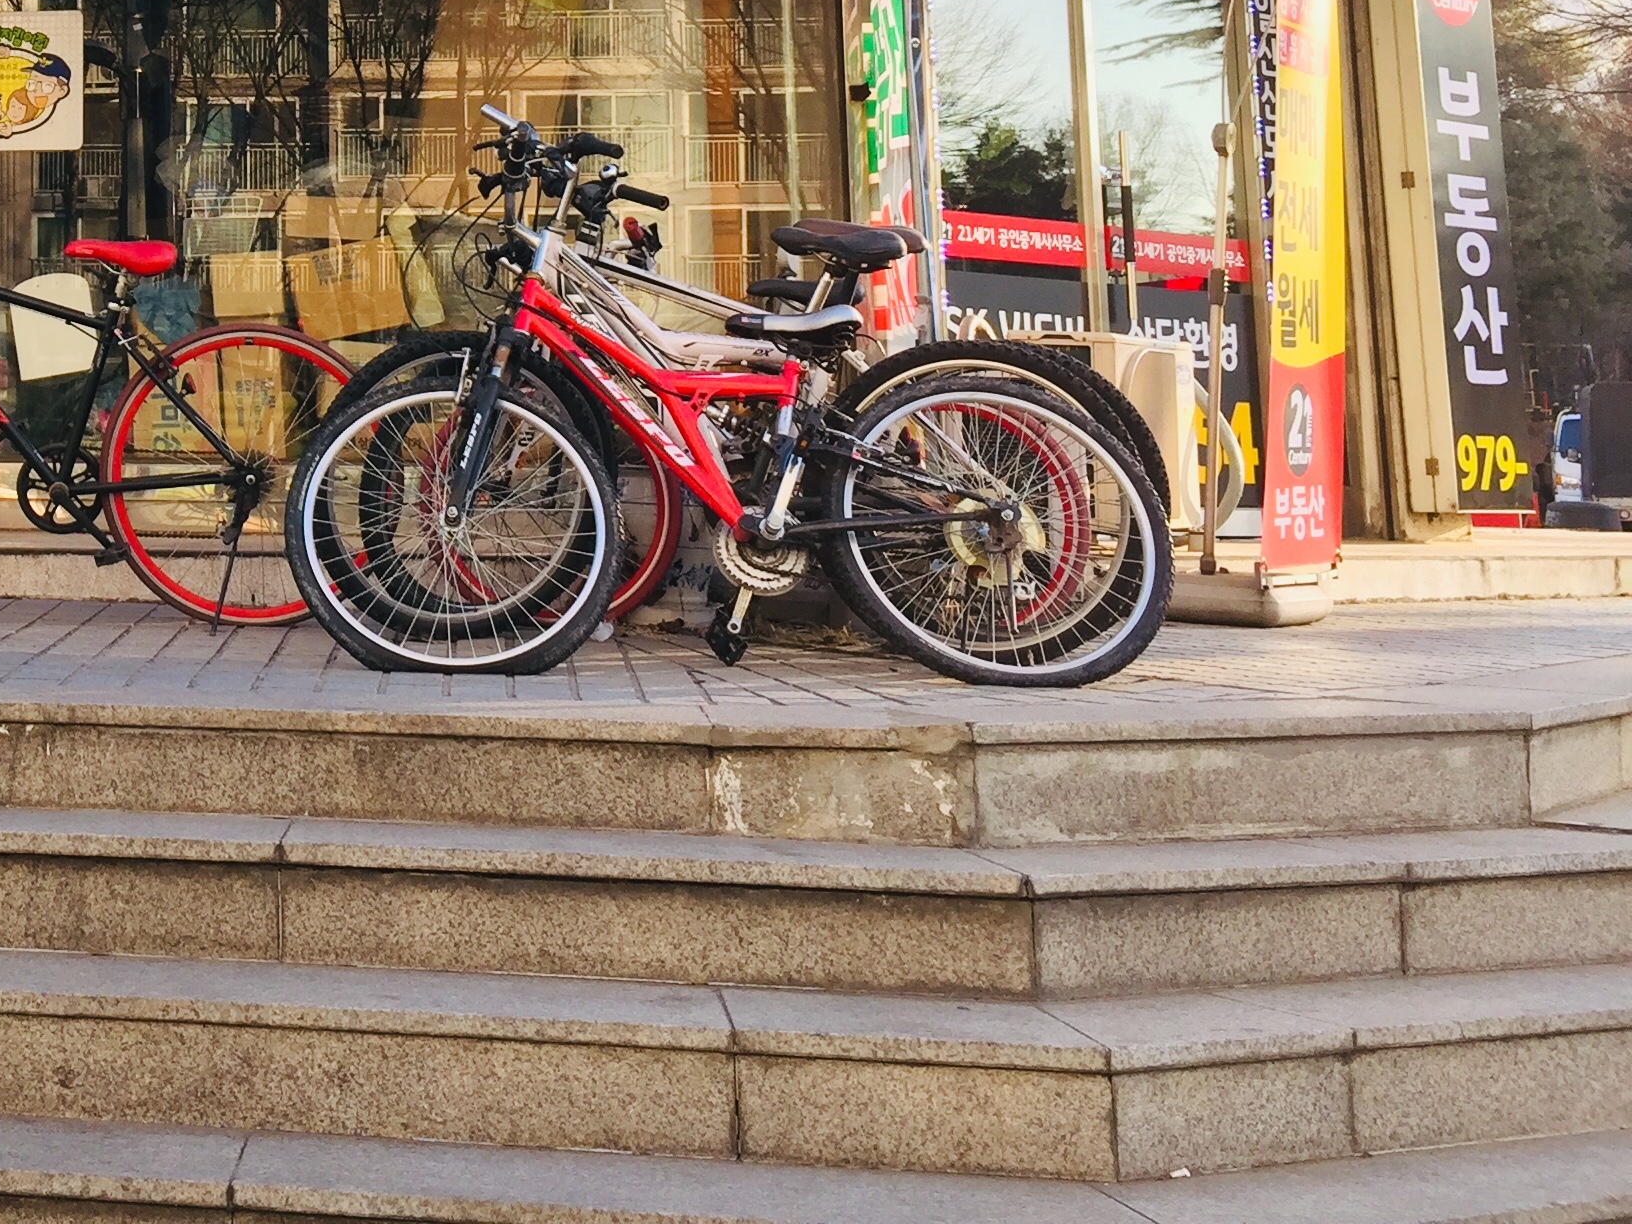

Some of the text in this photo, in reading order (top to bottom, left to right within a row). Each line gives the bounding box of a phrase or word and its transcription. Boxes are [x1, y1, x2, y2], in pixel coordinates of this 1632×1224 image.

[957, 224, 995, 246] 21세기
[1278, 180, 1319, 253] 전세
[1434, 65, 1510, 386] 부동산
[1277, 272, 1320, 349] 월세
[577, 353, 696, 467] LESPO
[1456, 433, 1529, 492] 979-
[1274, 483, 1326, 542] 부동산
